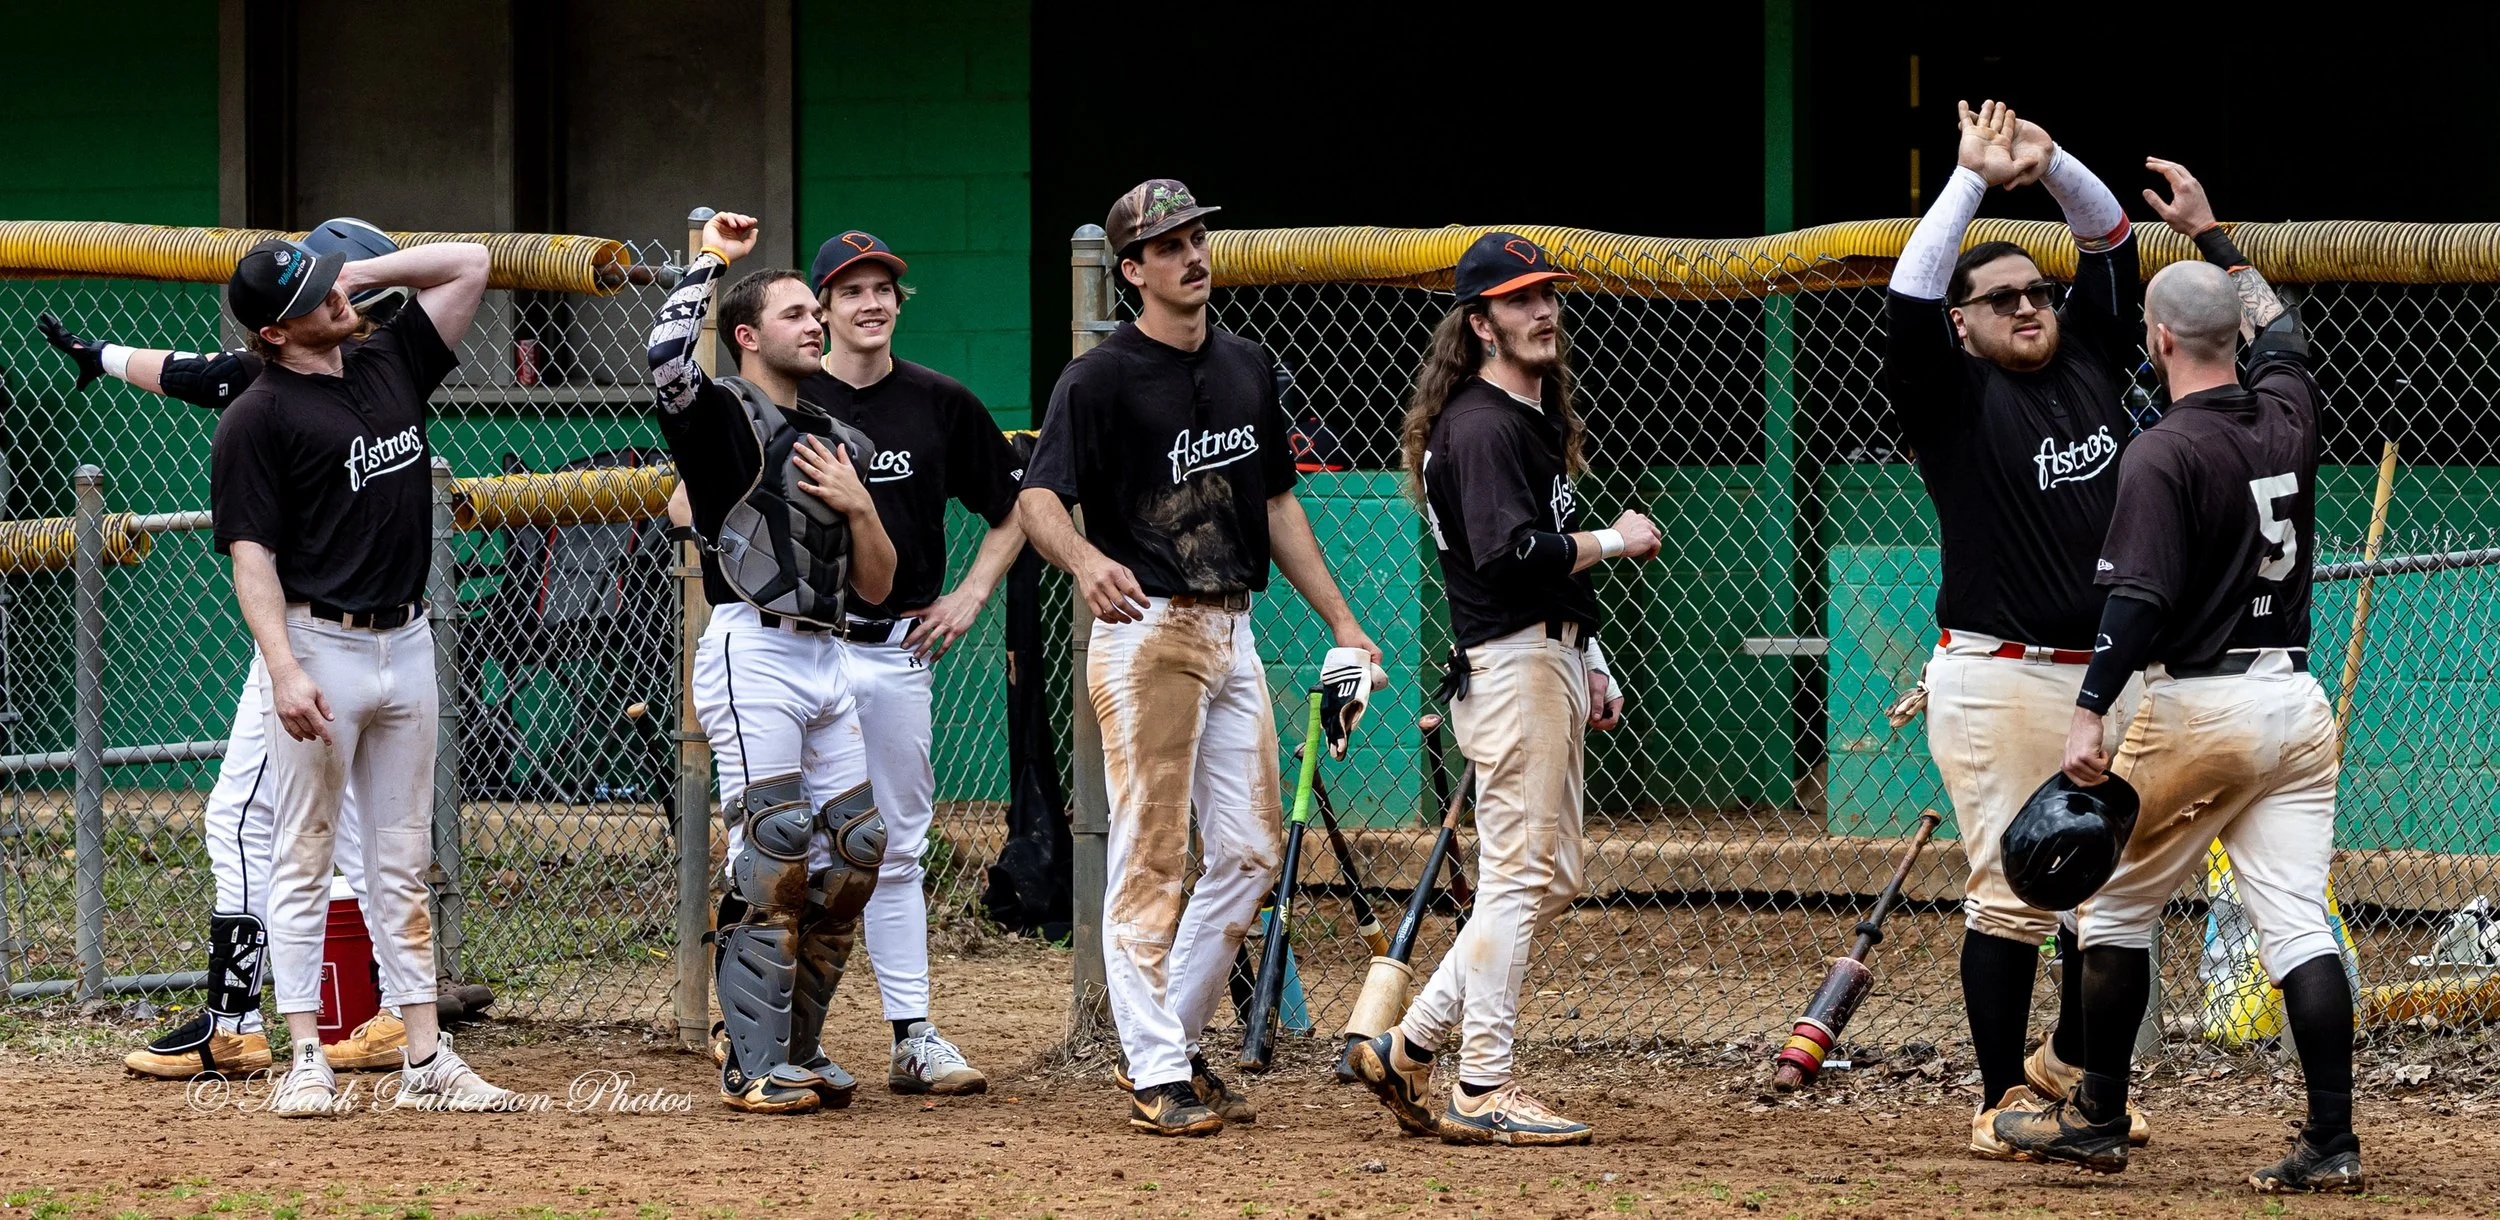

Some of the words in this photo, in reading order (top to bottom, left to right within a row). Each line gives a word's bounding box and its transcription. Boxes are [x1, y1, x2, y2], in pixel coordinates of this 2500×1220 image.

[344, 425, 424, 492] Astros
[1167, 425, 1259, 484] Astros
[2033, 425, 2118, 491] Astros
[2249, 472, 2299, 581] 5
